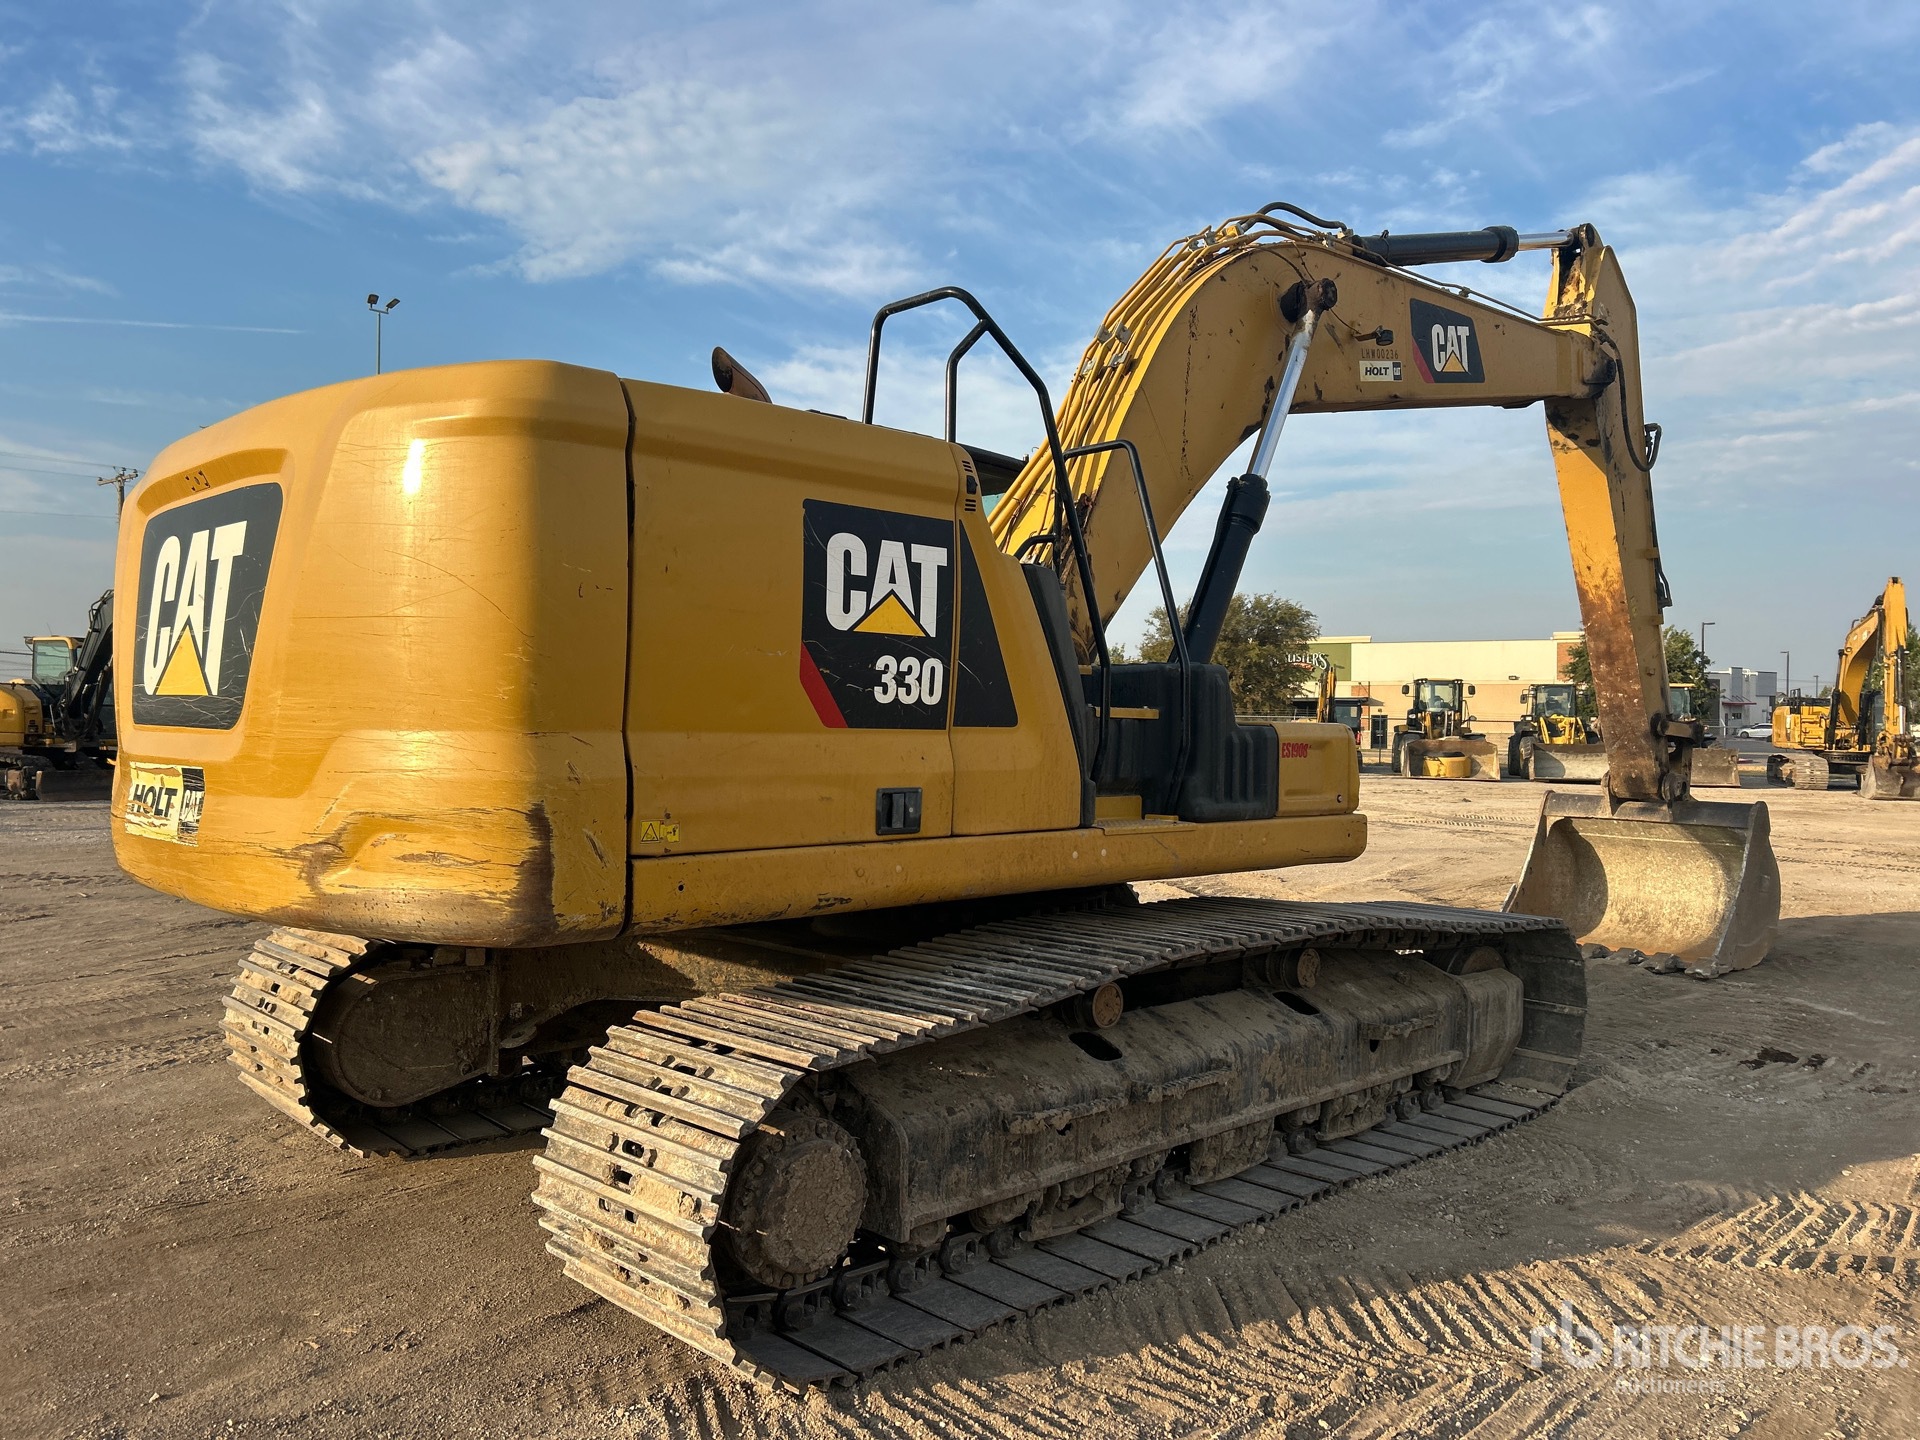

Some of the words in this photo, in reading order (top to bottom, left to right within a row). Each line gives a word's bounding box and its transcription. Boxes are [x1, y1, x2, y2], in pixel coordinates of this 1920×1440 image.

[1365, 366, 1390, 376] HOLT
[1431, 323, 1470, 373] CAT
[143, 520, 248, 696] CAT
[825, 532, 948, 638] CAT
[873, 655, 944, 705] 330
[132, 783, 179, 818] HOLT
[181, 789, 205, 823] CAT
